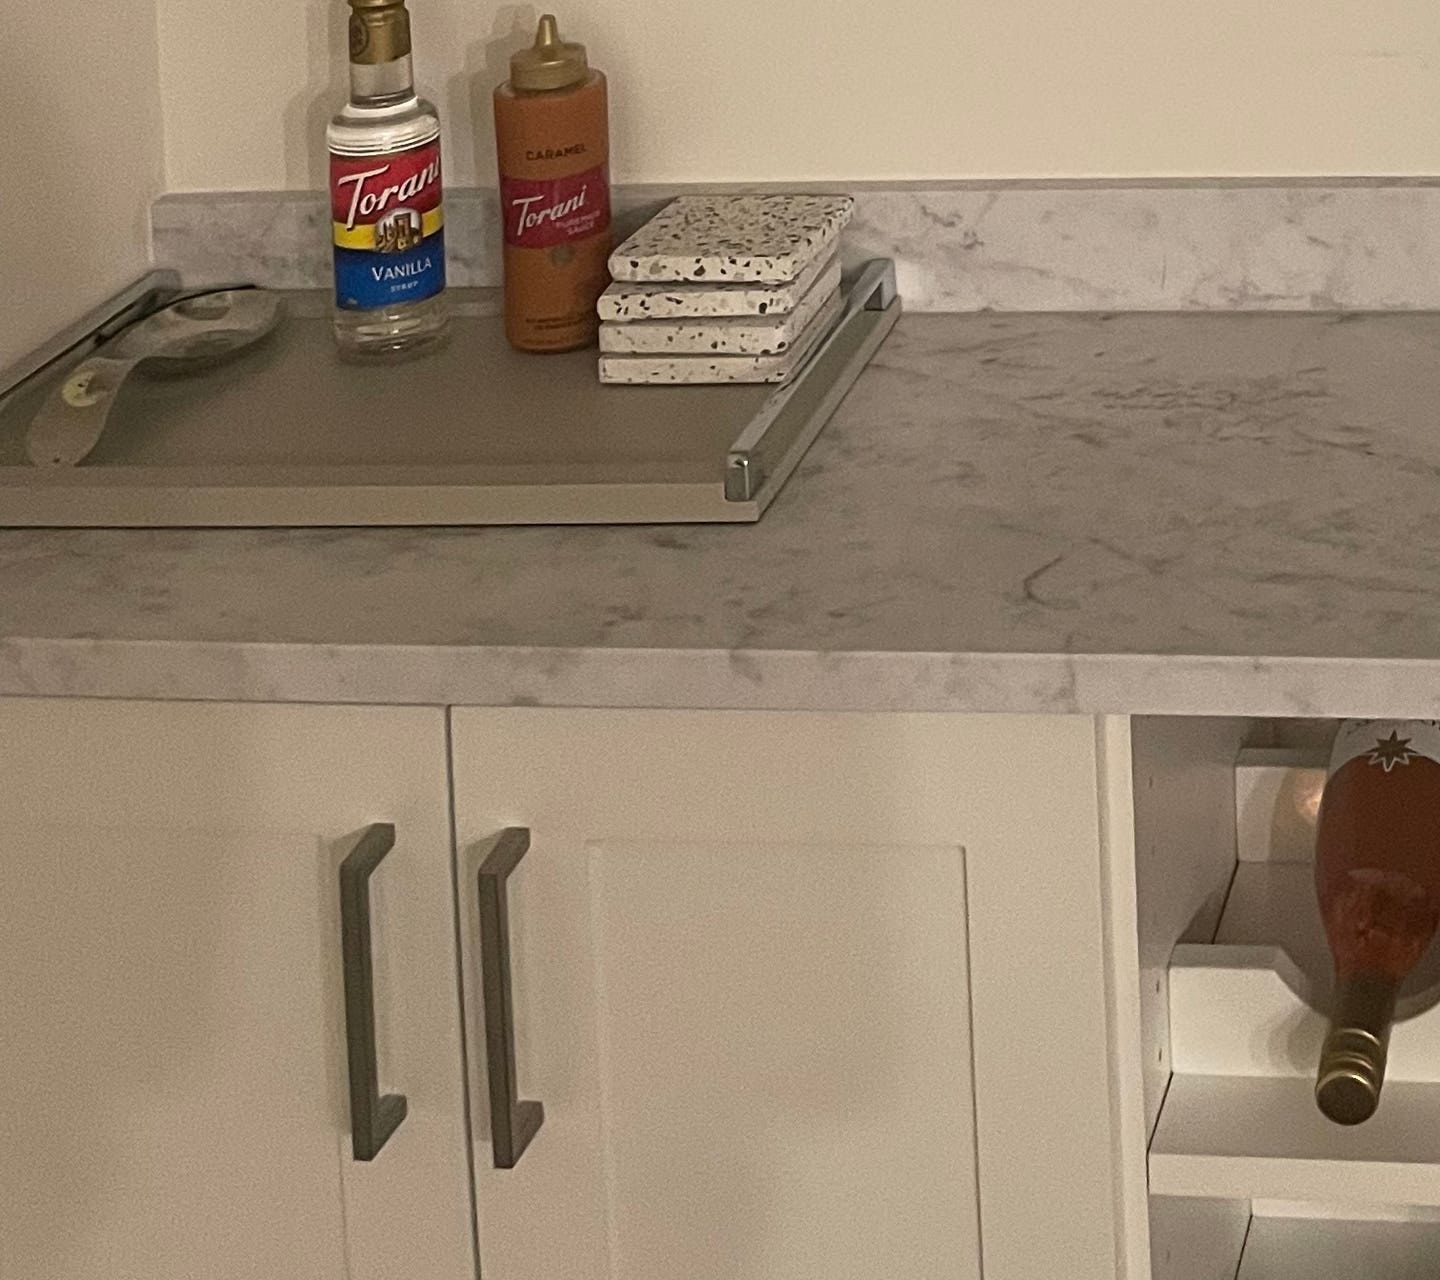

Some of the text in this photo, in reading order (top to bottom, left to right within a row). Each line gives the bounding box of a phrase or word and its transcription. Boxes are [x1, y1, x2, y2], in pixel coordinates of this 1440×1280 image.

[525, 143, 587, 161] CARAMEL
[512, 184, 588, 236] Torani
[371, 256, 433, 282] VANILLA
